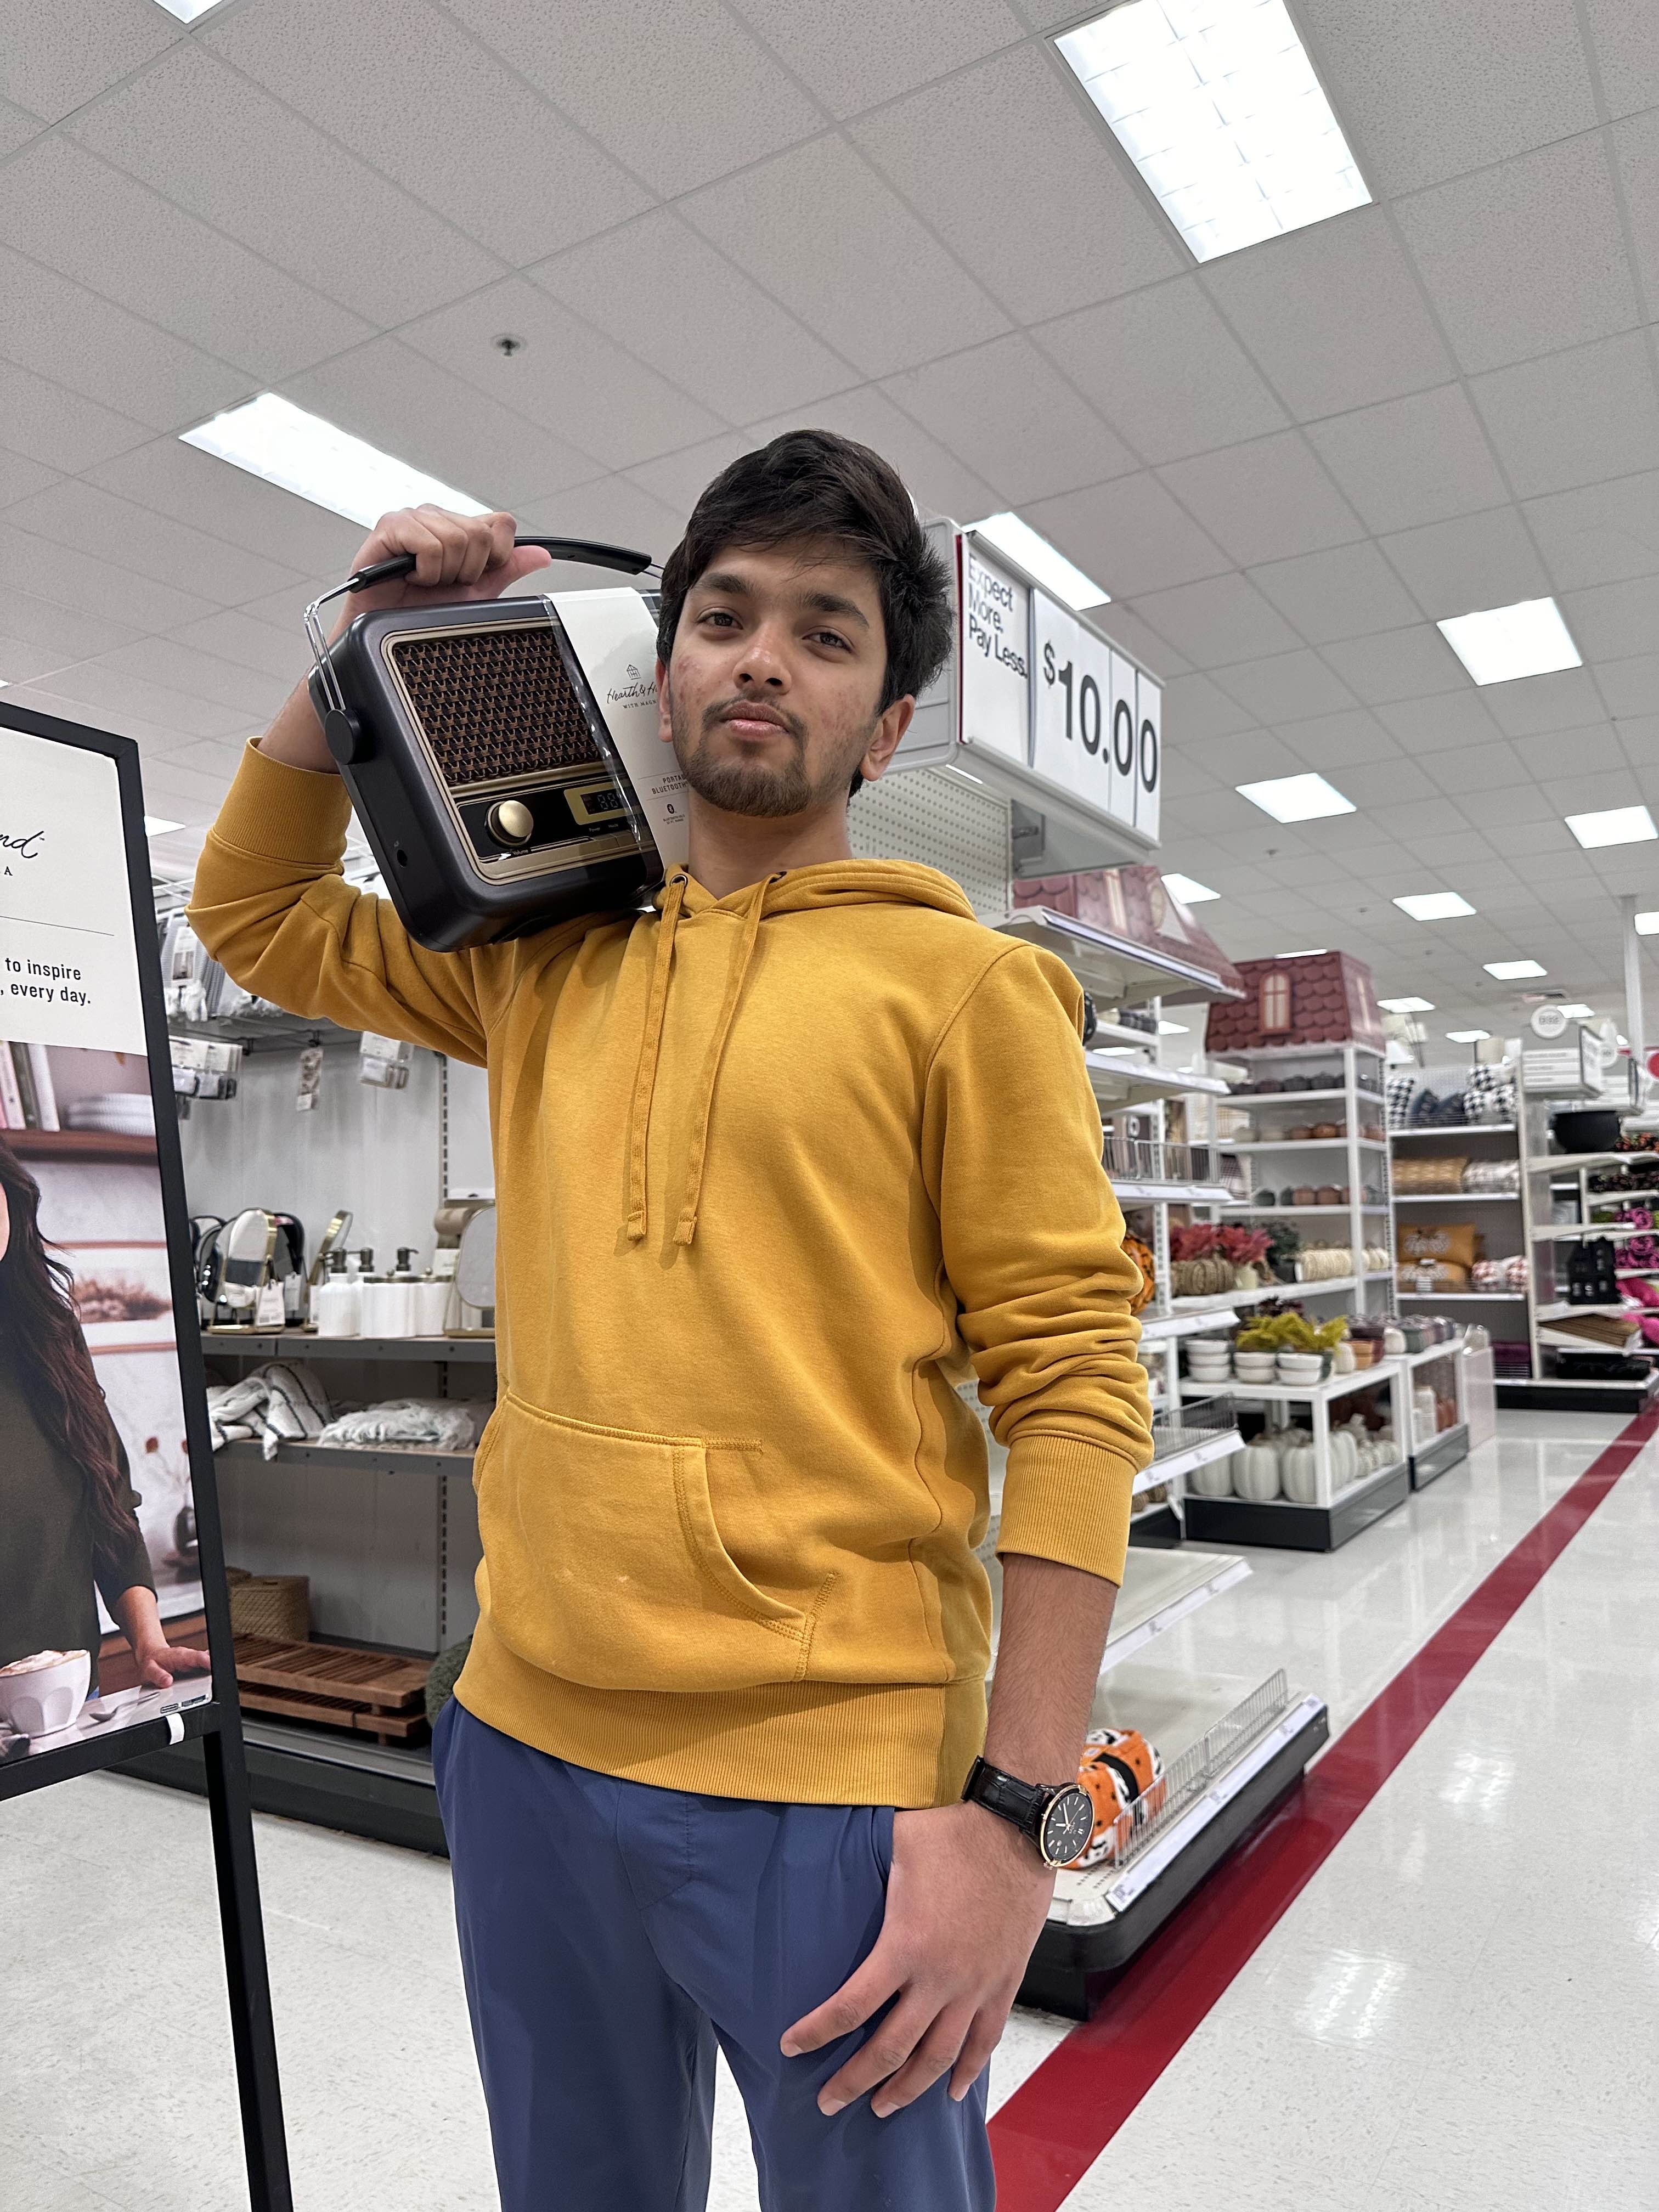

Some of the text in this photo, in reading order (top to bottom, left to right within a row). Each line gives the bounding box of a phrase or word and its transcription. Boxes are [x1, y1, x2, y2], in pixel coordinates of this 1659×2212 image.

[969, 553, 1013, 612] Expect
[969, 614, 1028, 679] Pay Less.
[607, 682, 640, 704] Hearth
[1043, 639, 1157, 793] $10.00
[5, 958, 81, 980] to inspire
[11, 984, 91, 1006] every day.
